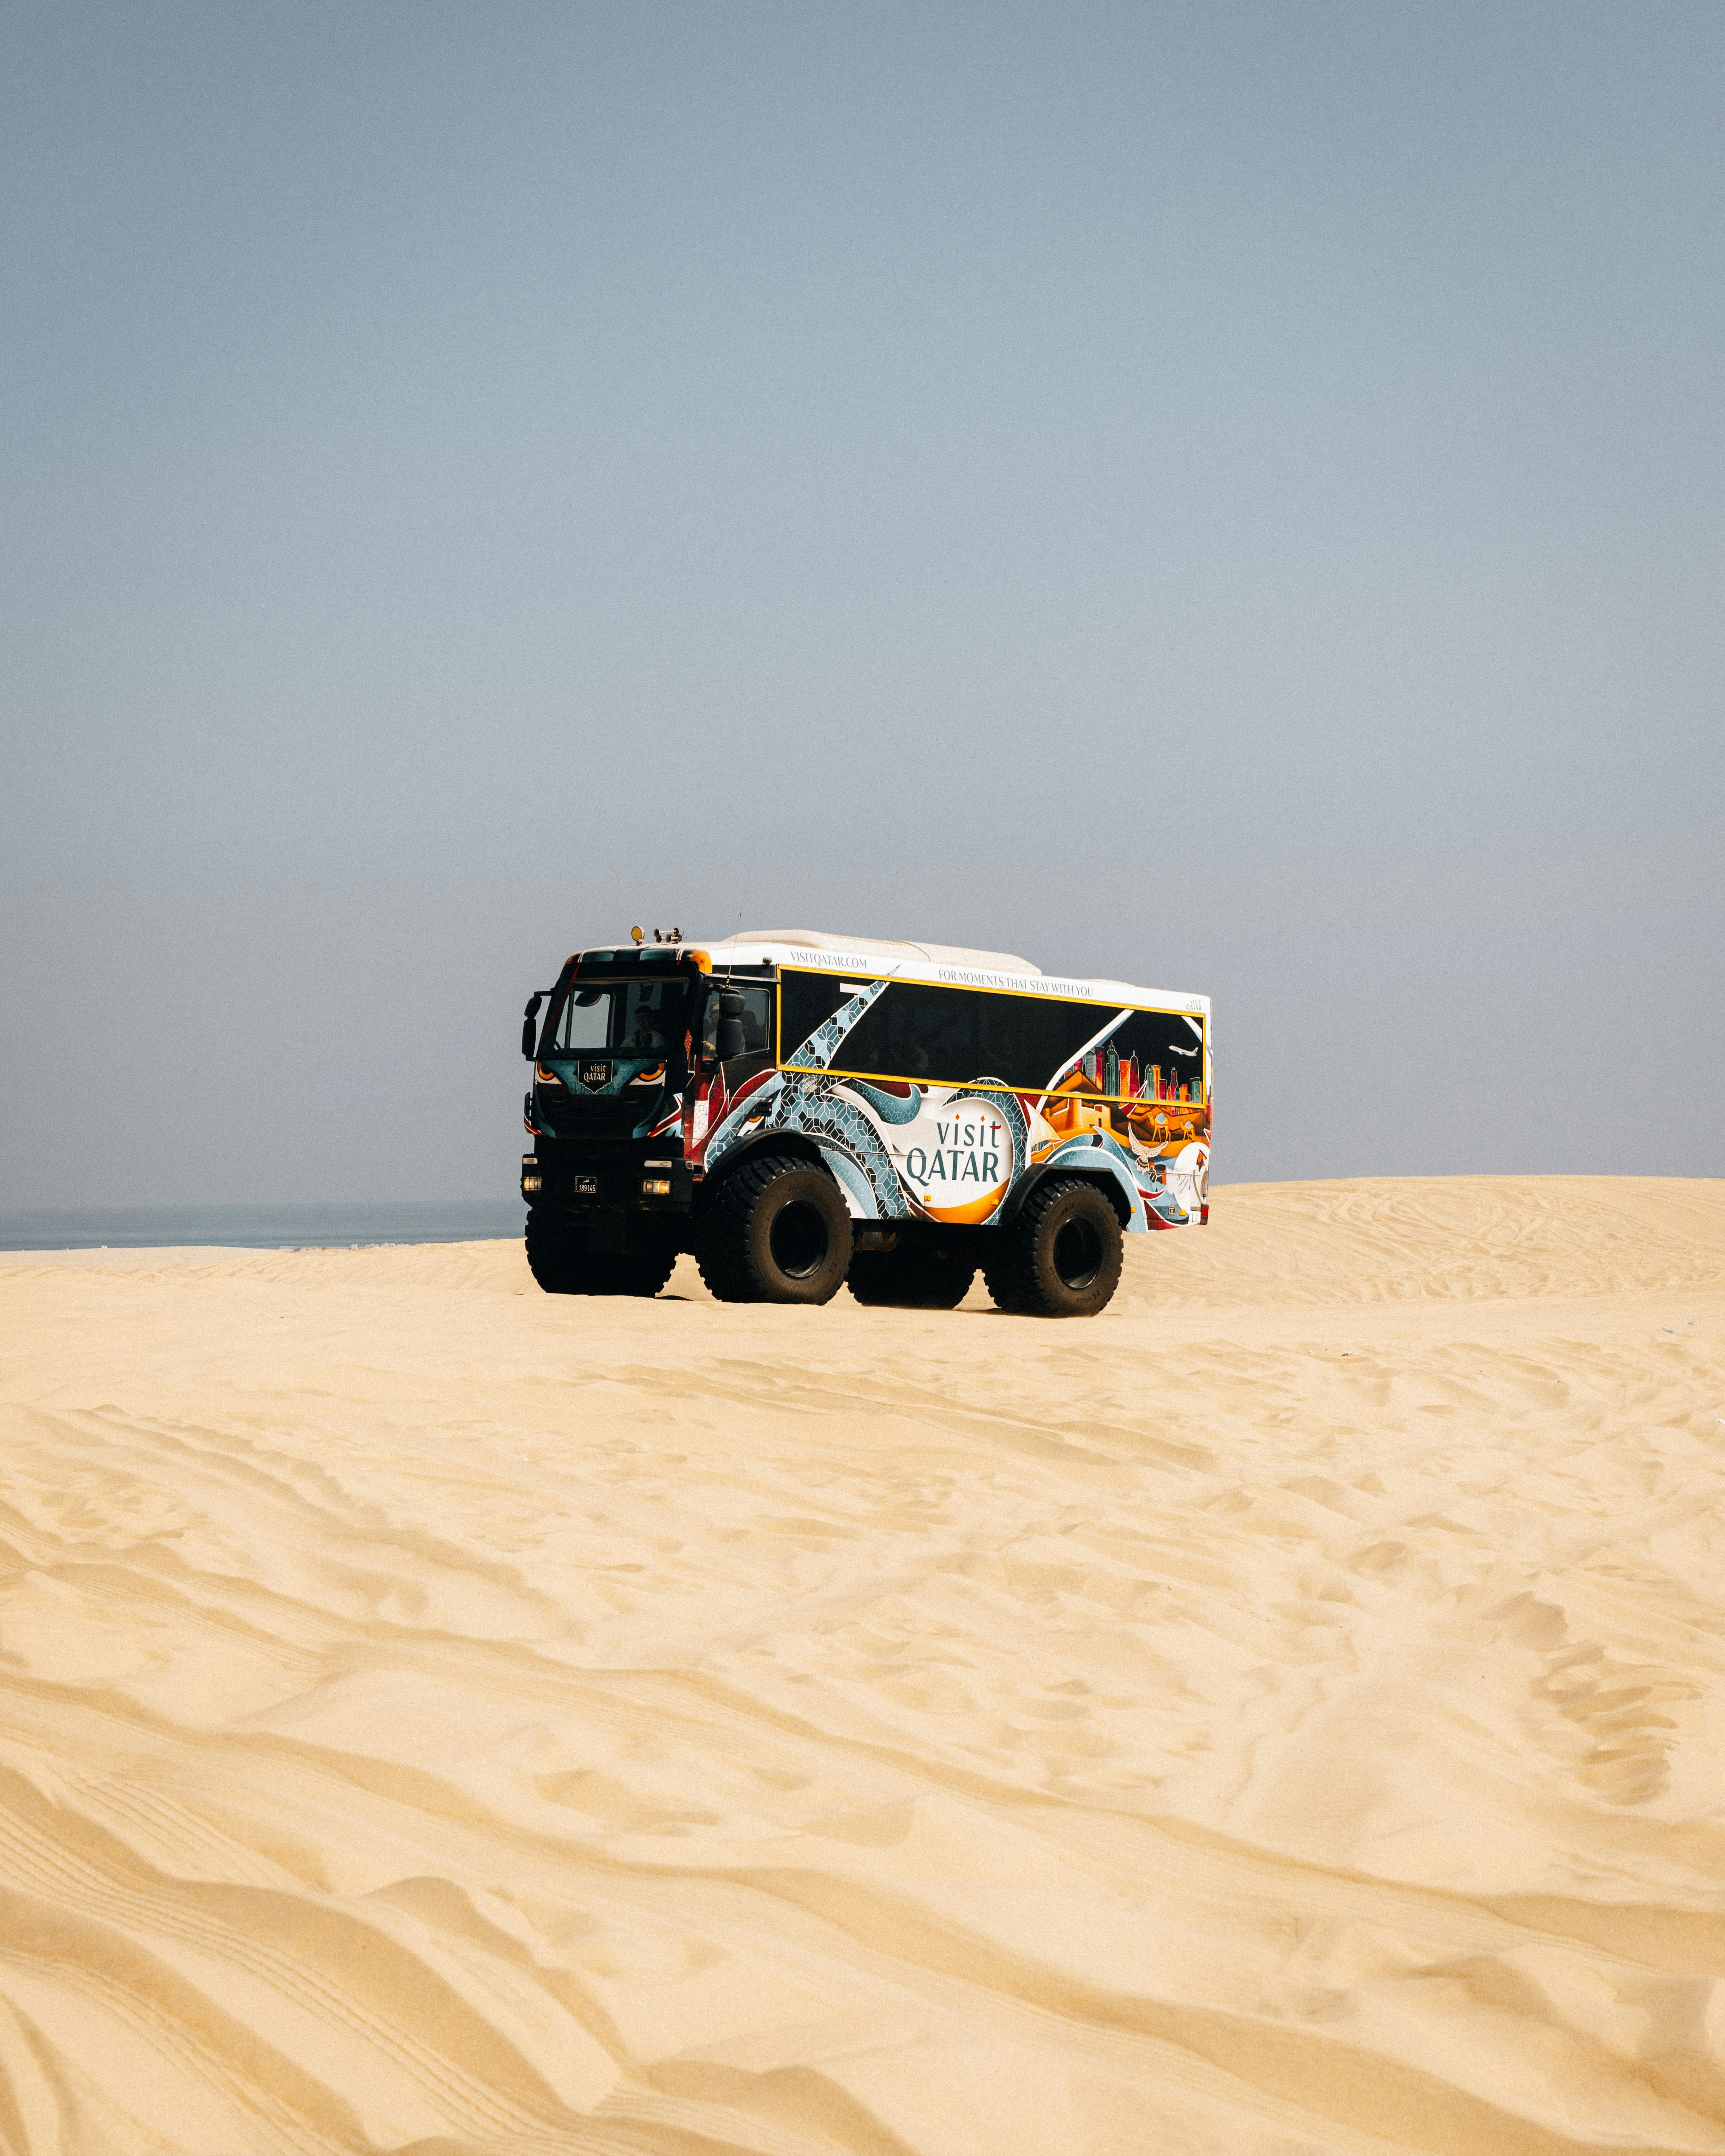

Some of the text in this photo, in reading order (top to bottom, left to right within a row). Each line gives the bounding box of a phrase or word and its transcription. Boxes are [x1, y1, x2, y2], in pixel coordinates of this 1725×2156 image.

[790, 951, 867, 969] VISITQATAR.COM
[939, 969, 1093, 997] FOR MOMENTS THAT STAY WITH YOU
[584, 1072, 606, 1082] QATAR
[590, 1063, 606, 1072] visit
[937, 1114, 1001, 1148] visit
[907, 1148, 999, 1186] QATAR
